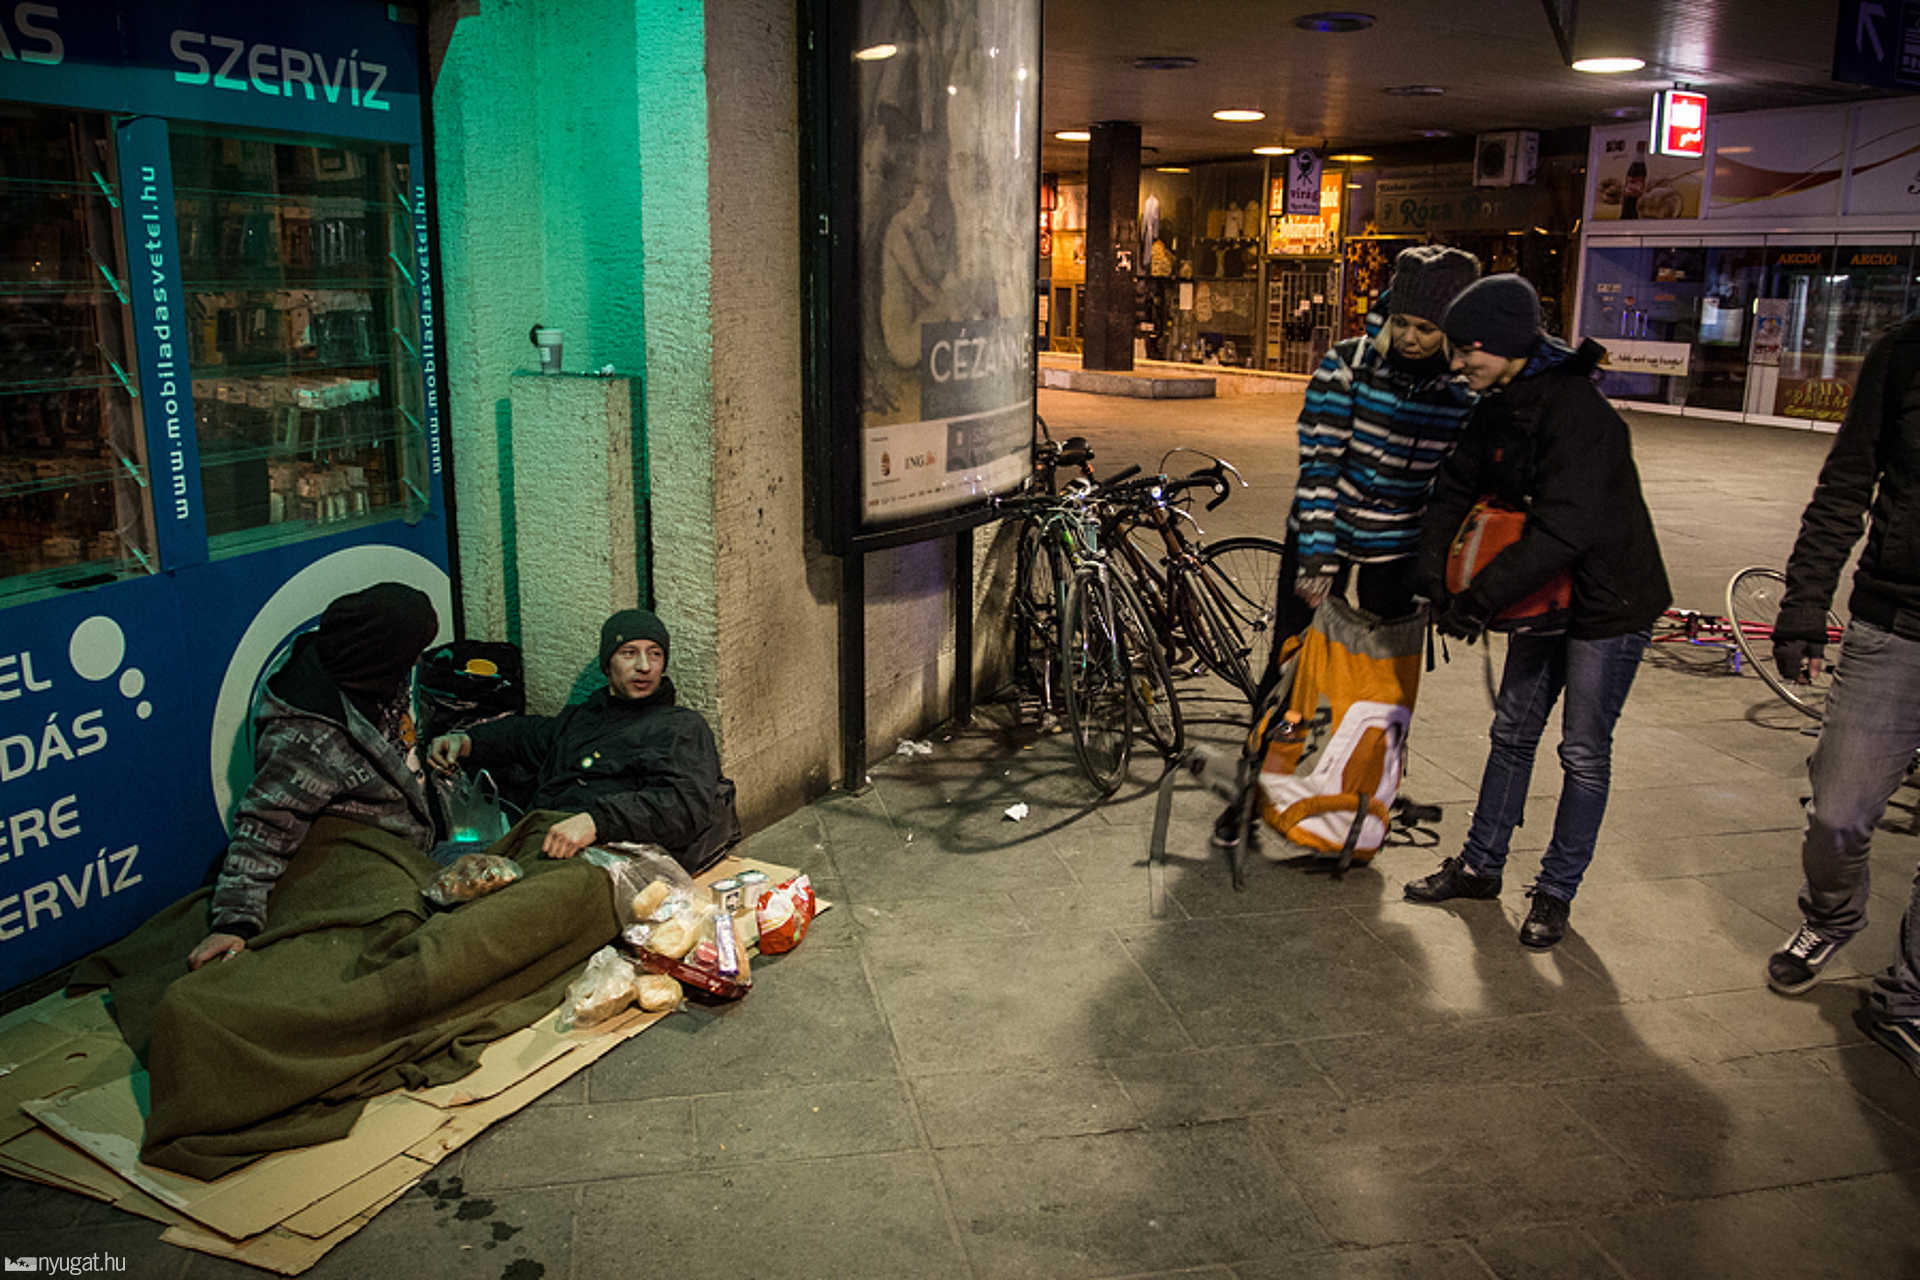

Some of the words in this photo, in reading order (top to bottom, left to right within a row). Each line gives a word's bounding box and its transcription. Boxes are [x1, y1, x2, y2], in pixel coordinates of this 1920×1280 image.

[170, 29, 390, 111] SZERVÍZ
[140, 167, 189, 520] www.mobiladasvetel.hu
[904, 455, 925, 470] ING
[0, 709, 108, 782] DÁS
